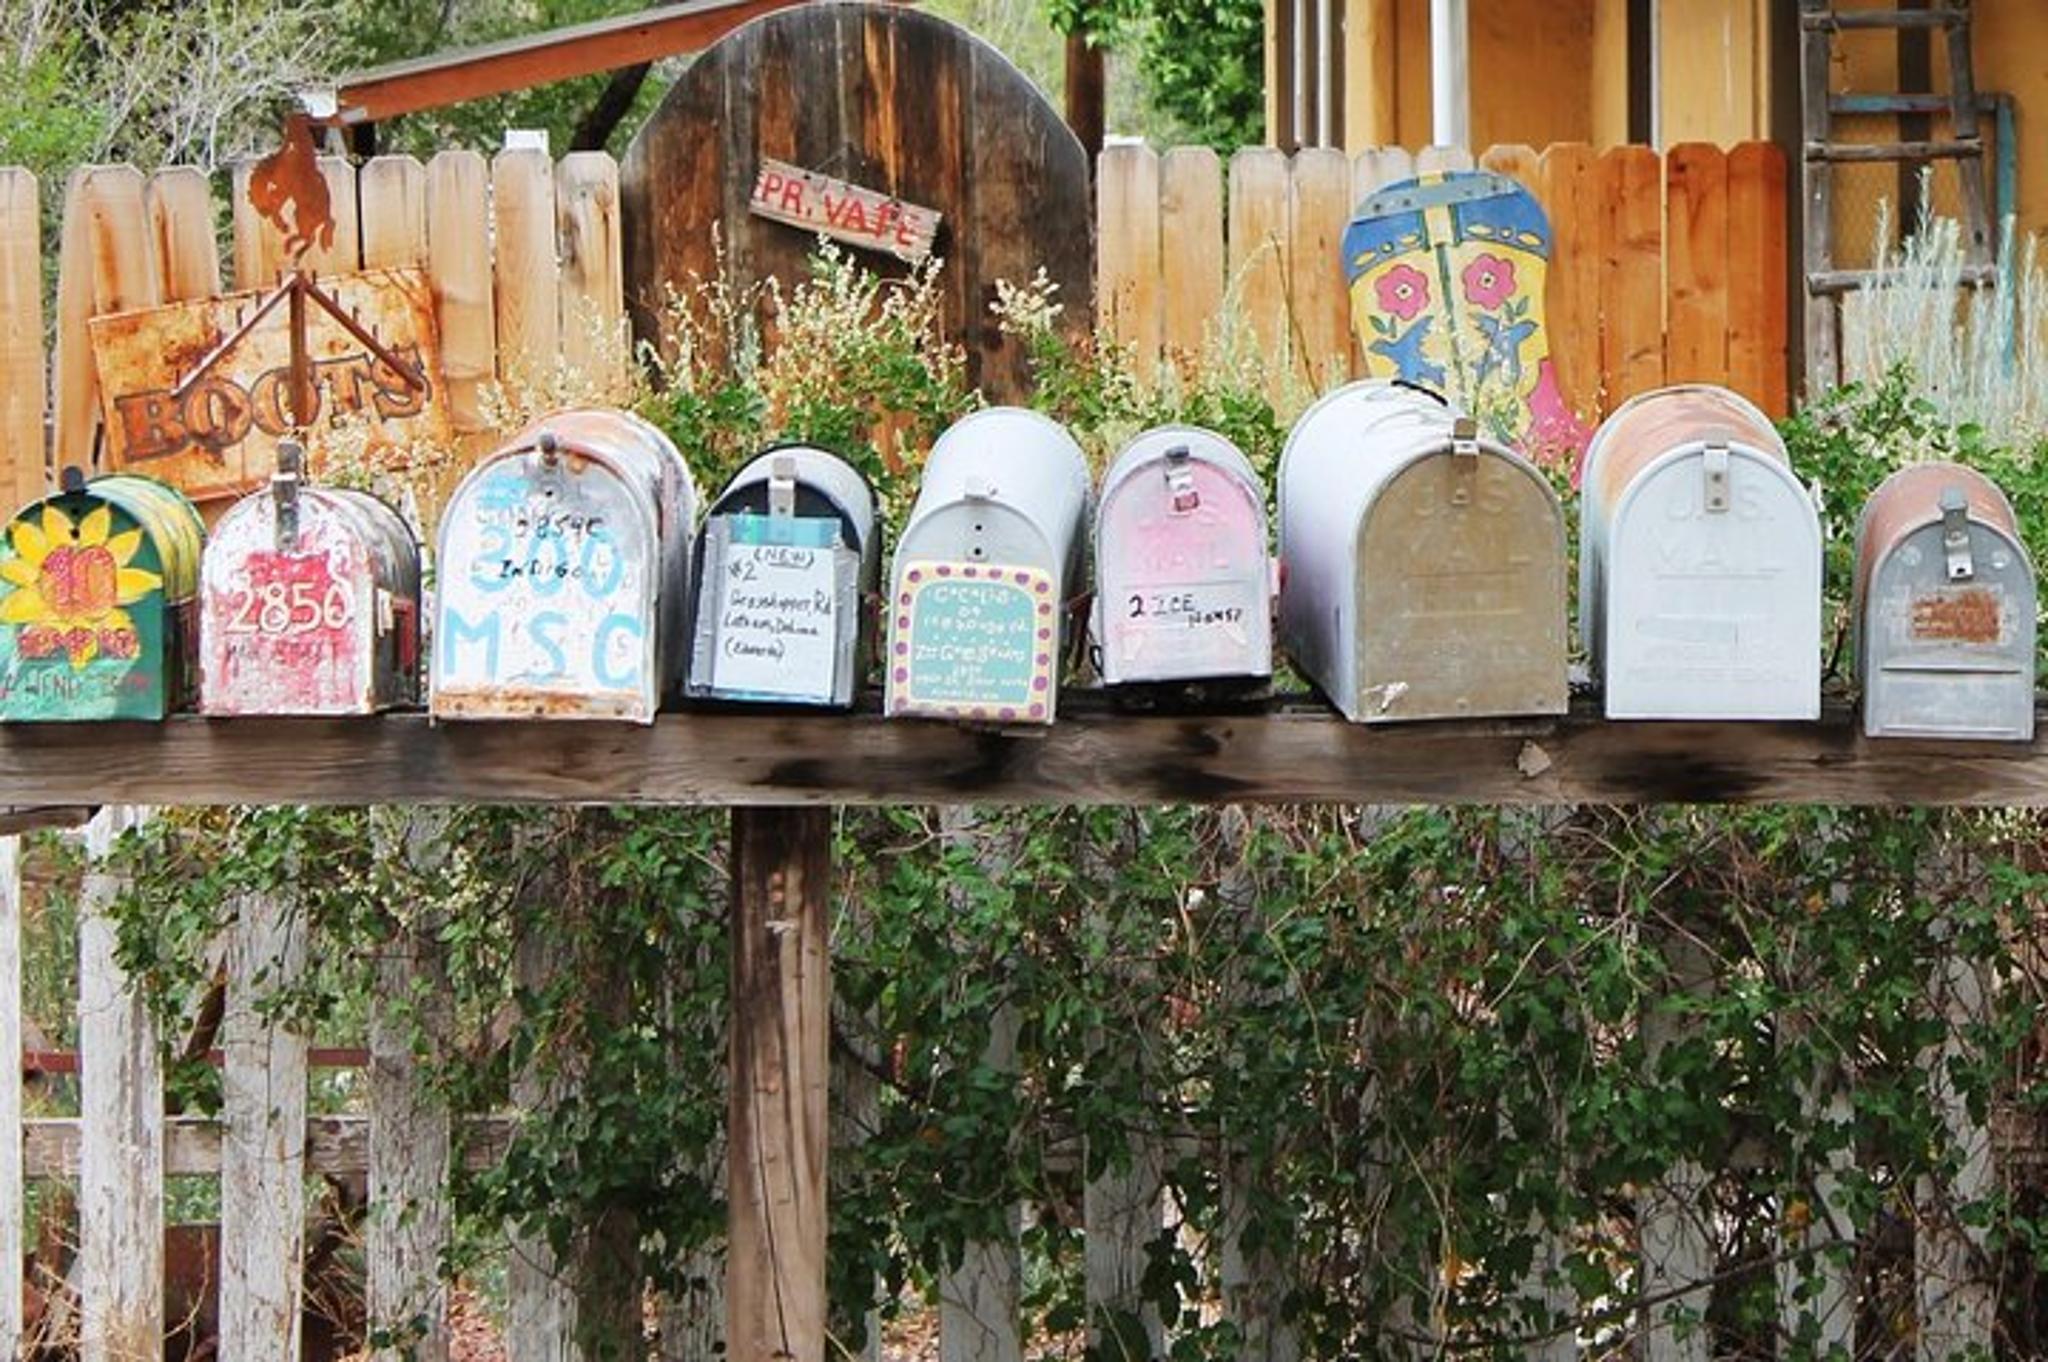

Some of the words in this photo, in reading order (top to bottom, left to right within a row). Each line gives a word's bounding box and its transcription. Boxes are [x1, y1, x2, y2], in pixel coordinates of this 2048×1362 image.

[760, 171, 921, 247] PRVATE
[470, 525, 626, 598] 300
[225, 580, 351, 633] 2850
[1128, 595, 1146, 618] 2
